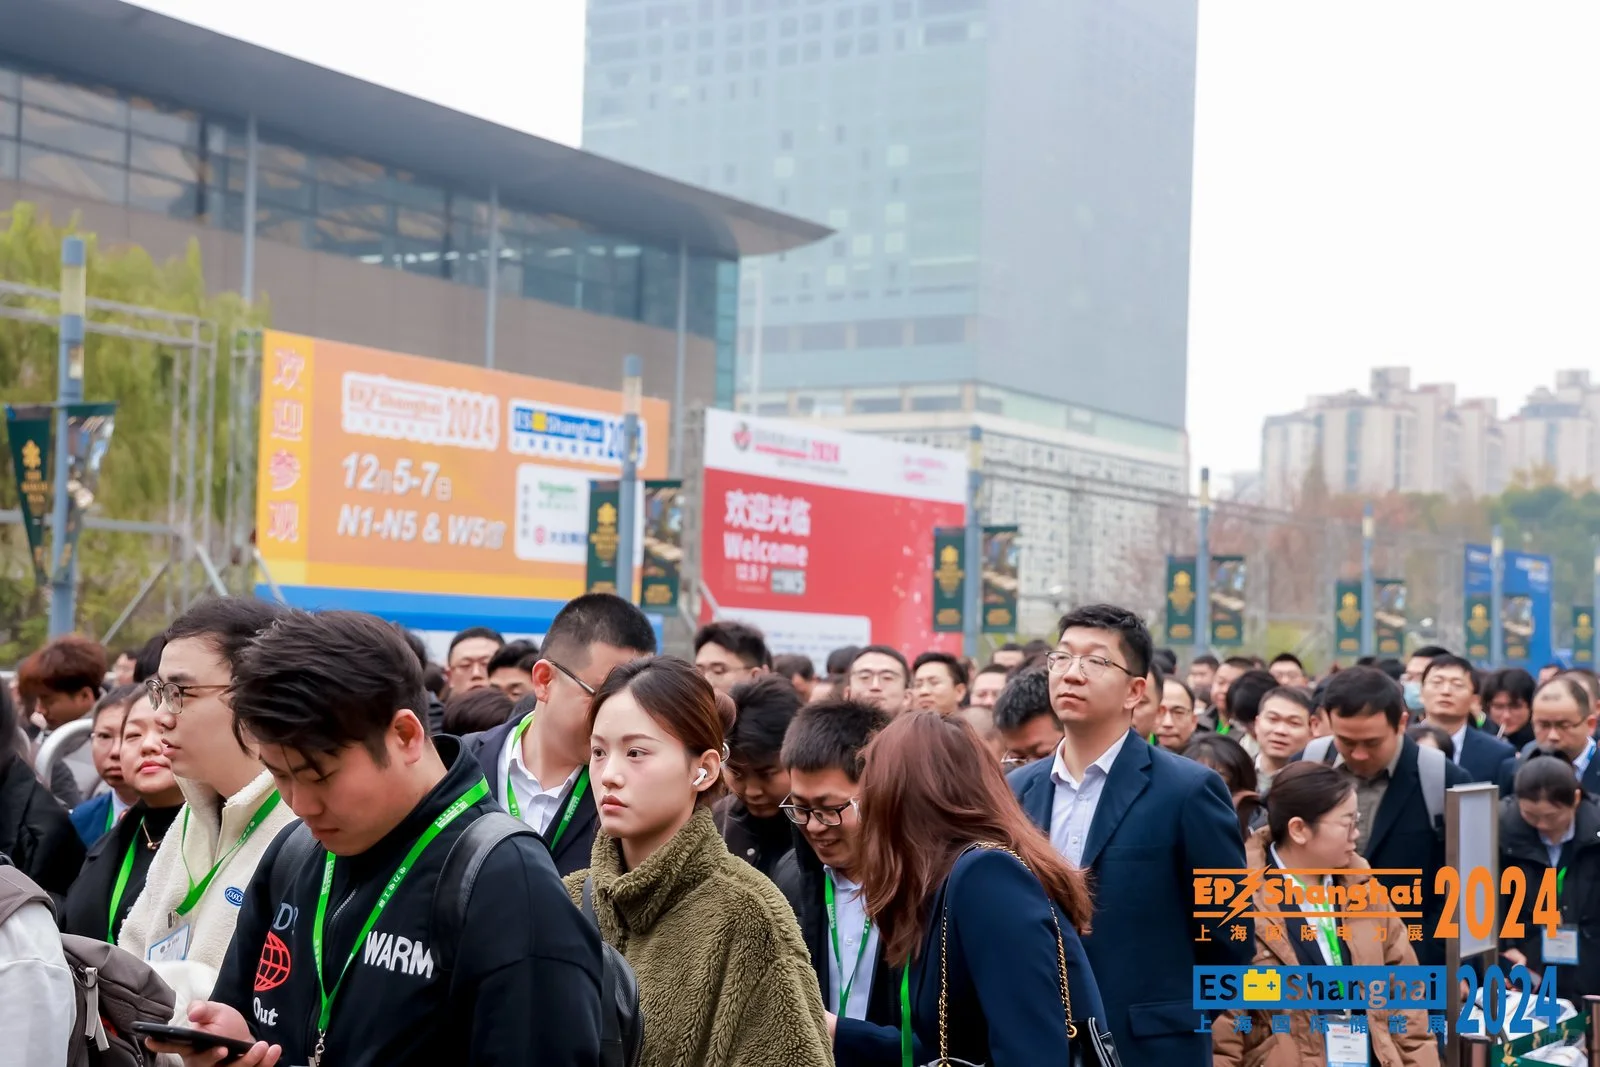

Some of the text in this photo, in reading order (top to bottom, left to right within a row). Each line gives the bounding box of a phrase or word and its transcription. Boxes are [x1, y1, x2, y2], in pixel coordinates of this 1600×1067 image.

[447, 394, 494, 441] 2024
[267, 348, 304, 543] 欢迎参观
[337, 503, 418, 541] N1-N5
[422, 511, 442, 543] &
[724, 488, 812, 537] 欢迎光临
[723, 531, 809, 567] Welcome
[363, 930, 435, 978] WARM
[253, 996, 278, 1026] Out
